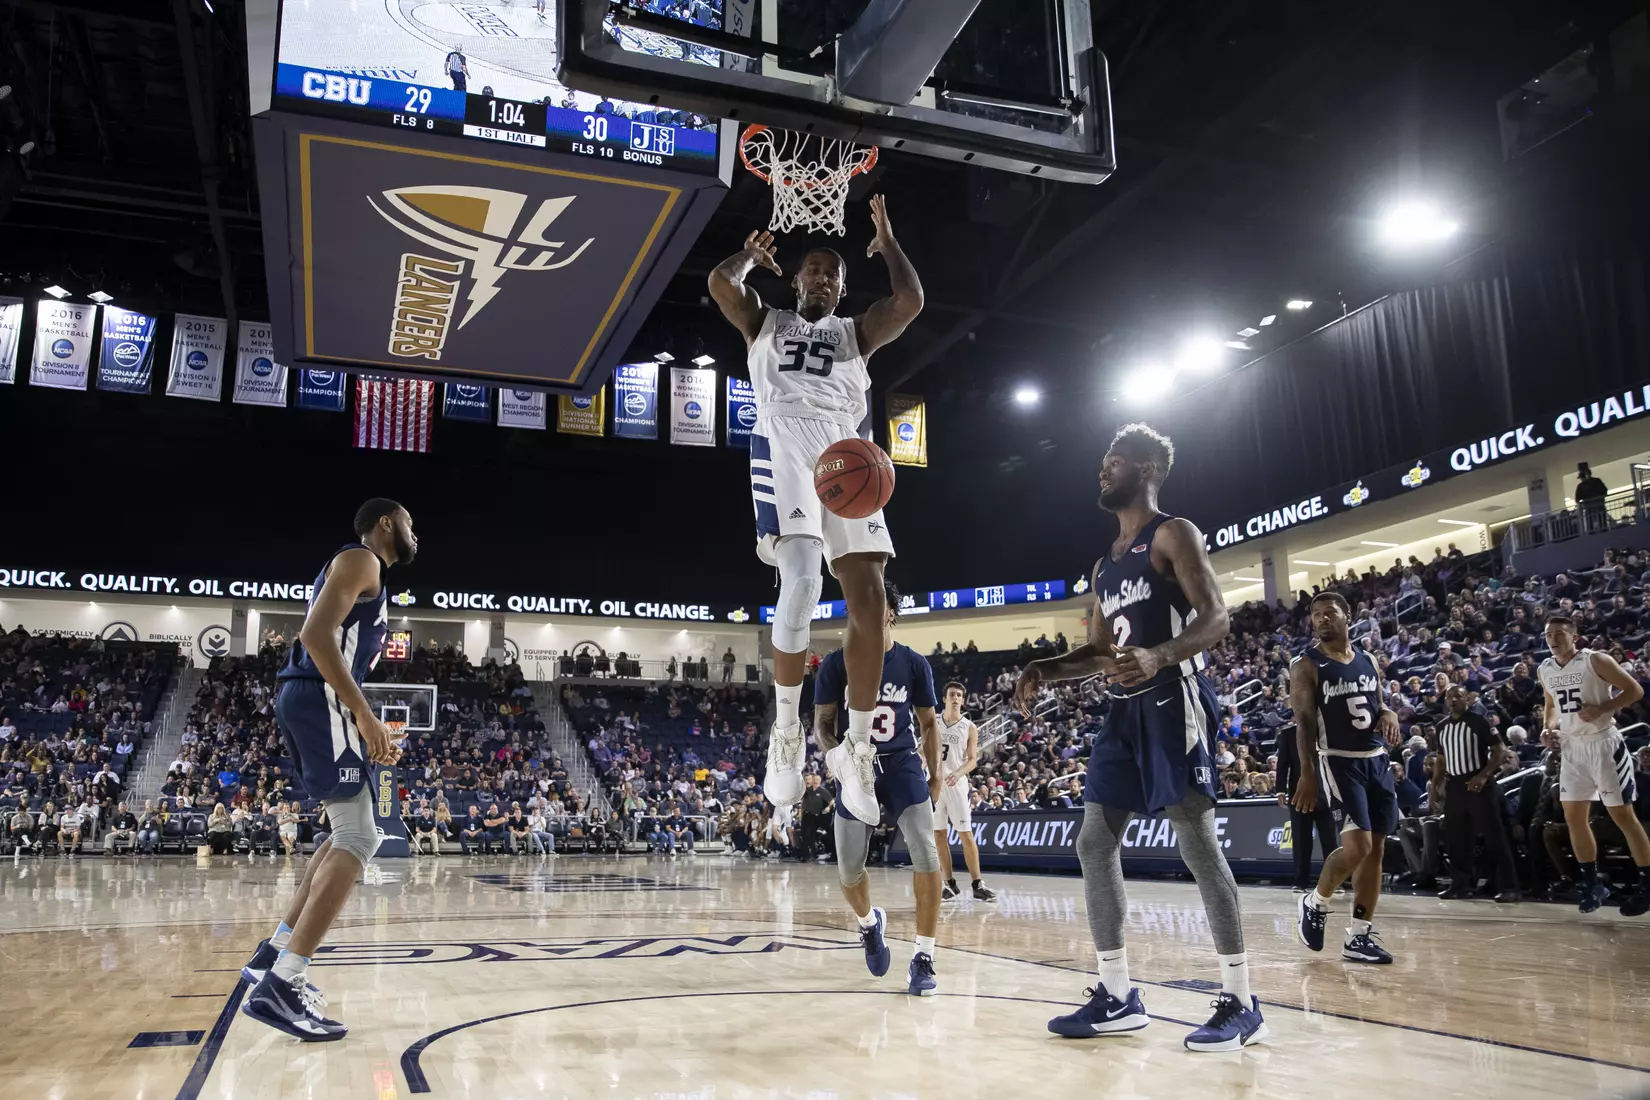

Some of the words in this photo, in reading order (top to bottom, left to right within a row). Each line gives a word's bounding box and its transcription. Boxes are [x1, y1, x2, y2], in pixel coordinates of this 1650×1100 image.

[302, 71, 372, 106] CBU
[405, 87, 432, 114] 29
[488, 101, 525, 126] 1:04
[393, 114, 417, 127] FLS
[427, 120, 434, 130] 8
[583, 115, 607, 141] 30
[478, 127, 498, 139] 1ST
[506, 132, 537, 144] HALF
[572, 142, 594, 155] FLS
[600, 147, 614, 158] 10
[623, 150, 662, 165] BONUS
[51, 308, 82, 320] 2016
[388, 252, 465, 361] LANCERS
[52, 321, 77, 329] MEN'S
[116, 325, 141, 333] MEN'S
[186, 322, 215, 333] 2015
[39, 328, 90, 338] BASKETBALL
[186, 333, 211, 341] MEN'S
[250, 329, 272, 338] 201
[775, 324, 841, 346] LANERS
[176, 339, 222, 350] BASKETBALL
[239, 347, 274, 355] BASKETB
[42, 361, 74, 370] DIVISION
[778, 341, 836, 377] 35
[34, 366, 85, 377] TOURNAMENT
[174, 372, 211, 381] DIVISION
[176, 380, 202, 389] SWEET
[237, 385, 284, 394] TOURNAMENT
[244, 379, 274, 387] DIVISION
[615, 383, 655, 393] BASKETBALL
[297, 387, 343, 397] CHAMPIONS
[446, 397, 489, 408] CHAMPIONS
[563, 410, 593, 418] DIVISION
[563, 417, 598, 425] NATIONAL
[615, 417, 655, 425] CHAMPIONS
[561, 422, 589, 430] RUNNER
[673, 427, 712, 435] TOURNAMENT
[1450, 424, 1545, 472] QUICK.
[1216, 524, 1244, 547] OIL
[1246, 496, 1329, 537] CHANGE.
[0, 568, 71, 588] QUICK.
[80, 573, 180, 593] QUALITY.
[188, 579, 223, 596] OIL
[1121, 576, 1151, 606] State
[433, 592, 500, 611] QUICK.
[507, 596, 593, 615] QUALITY.
[600, 600, 631, 617] OIL
[634, 602, 715, 621] CHANGE.
[943, 592, 958, 608] 30
[812, 604, 833, 619] BU
[32, 629, 94, 637] ACADEMICALLY
[392, 633, 410, 641] 1:04
[1113, 615, 1131, 659] 2
[386, 643, 406, 658] 23
[1549, 672, 1582, 688] LANCERS
[883, 683, 908, 703] State
[1323, 677, 1358, 704] Jackson
[1557, 688, 1582, 713] 25
[1346, 696, 1372, 730] 5
[872, 706, 896, 742] 3
[378, 770, 392, 817] CBU
[993, 820, 1073, 848] QUALITY.
[1121, 817, 1232, 849] CHAE.
